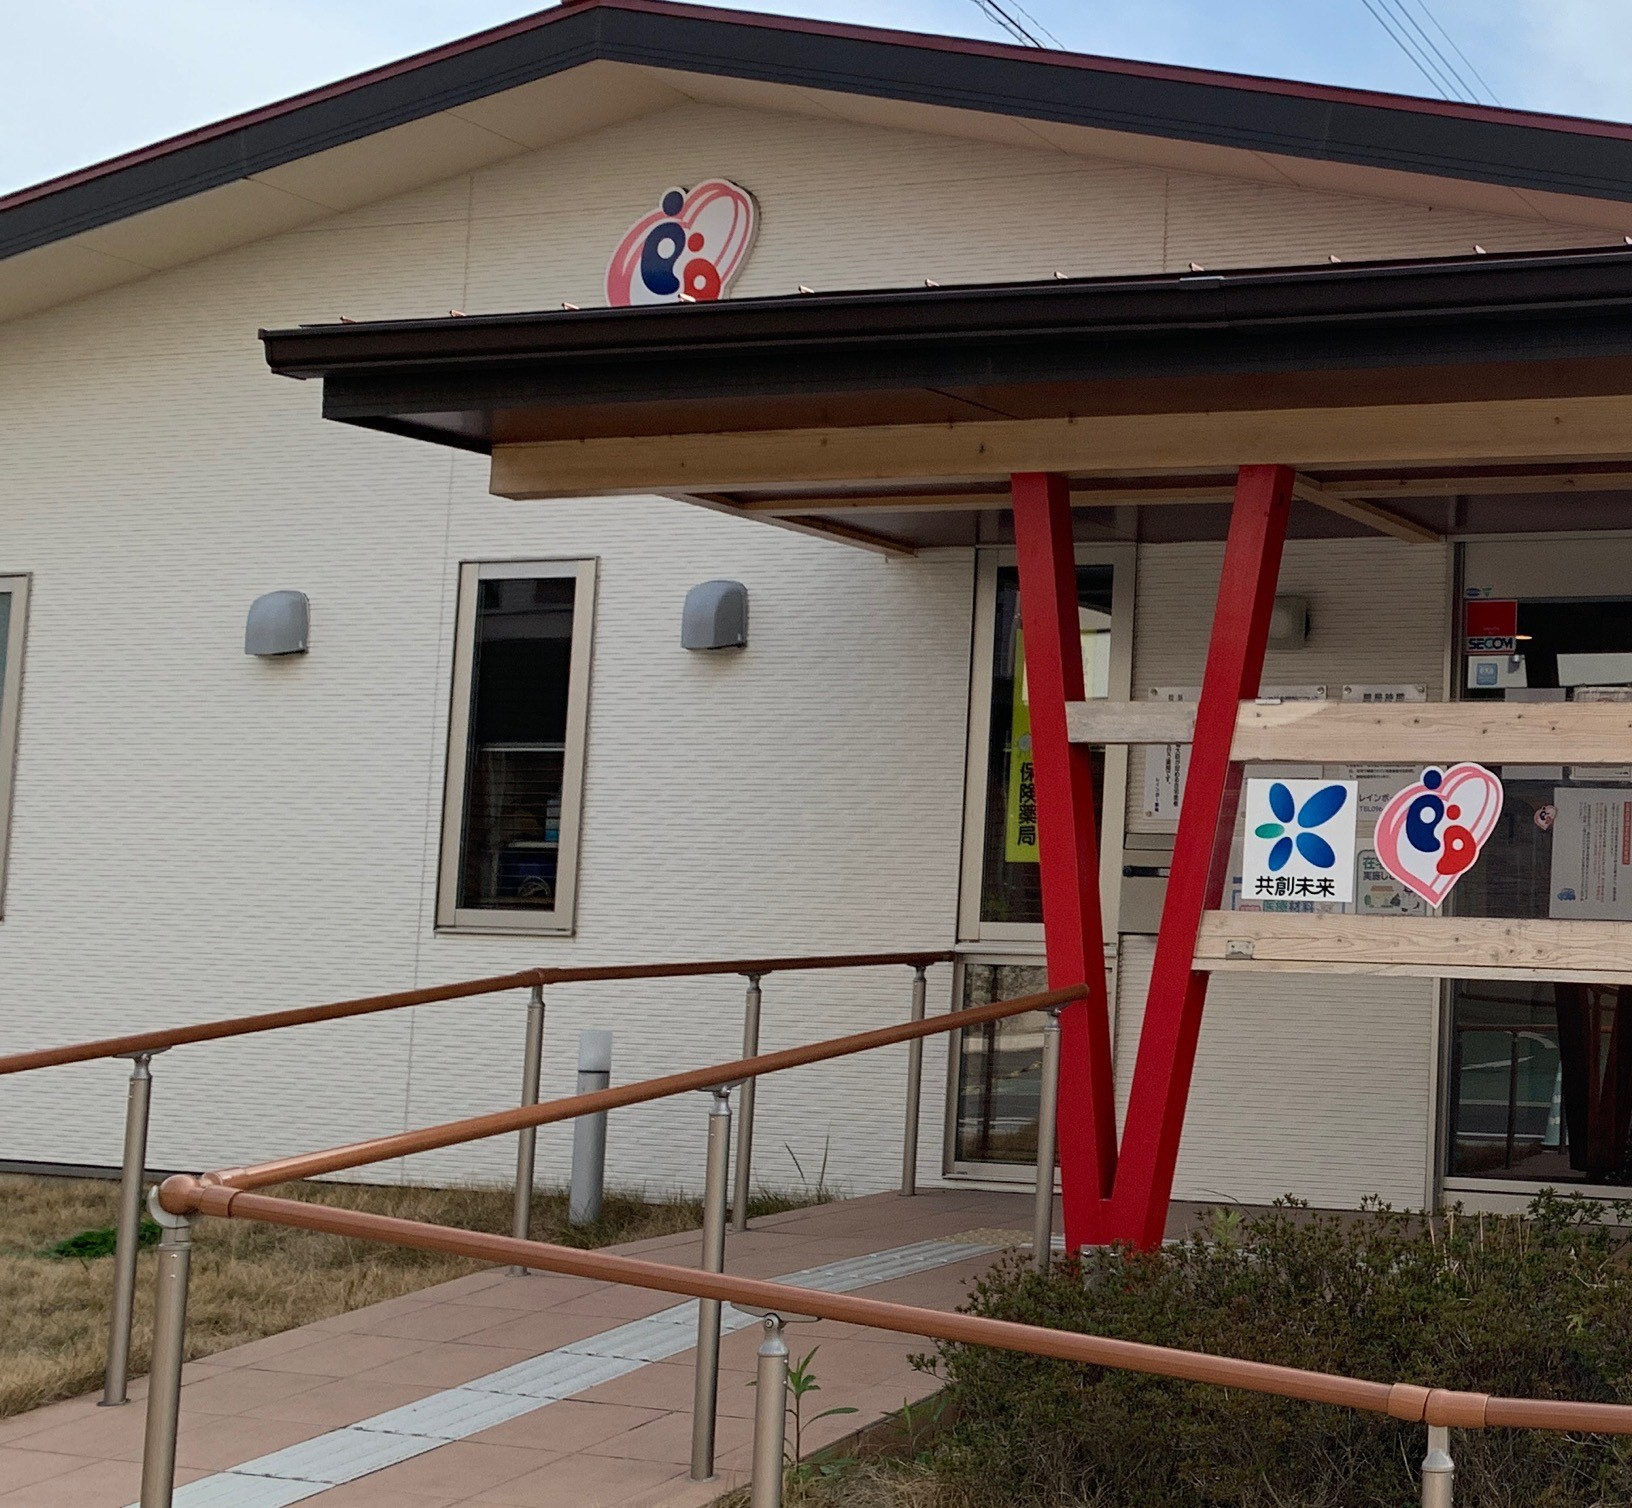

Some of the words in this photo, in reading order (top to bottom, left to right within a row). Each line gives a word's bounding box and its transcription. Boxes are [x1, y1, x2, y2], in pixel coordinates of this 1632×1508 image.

[1469, 637, 1513, 650] SECOM
[1018, 762, 1036, 845] 保険薬局
[1359, 793, 1393, 802] レインボ
[1255, 876, 1335, 898] 共創未来
